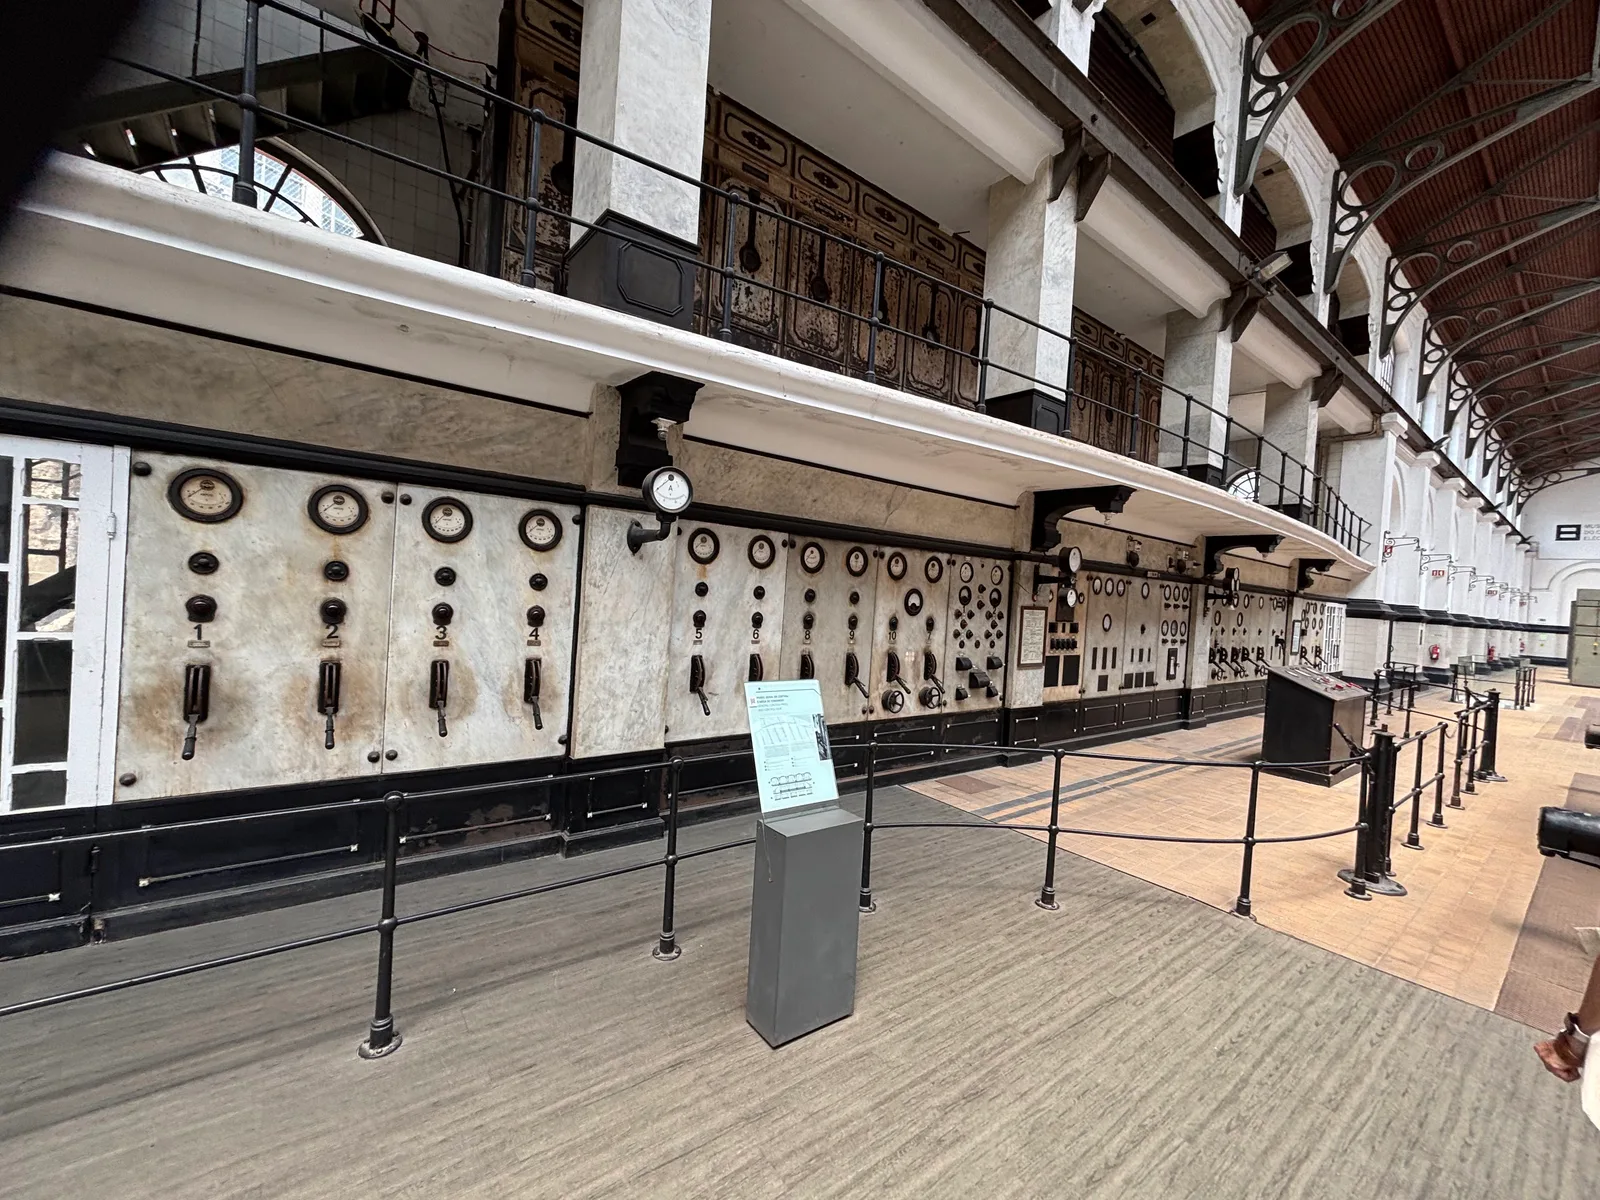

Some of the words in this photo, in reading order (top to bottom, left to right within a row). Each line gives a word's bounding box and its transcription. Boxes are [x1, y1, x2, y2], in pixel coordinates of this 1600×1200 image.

[193, 624, 202, 640] 1
[325, 624, 339, 639] 2
[434, 625, 447, 640] 3
[528, 627, 540, 640] 4
[695, 628, 703, 640] 5
[752, 629, 760, 640] 6
[804, 630, 811, 640] 8
[849, 630, 855, 640] 9
[888, 631, 897, 640] 10
